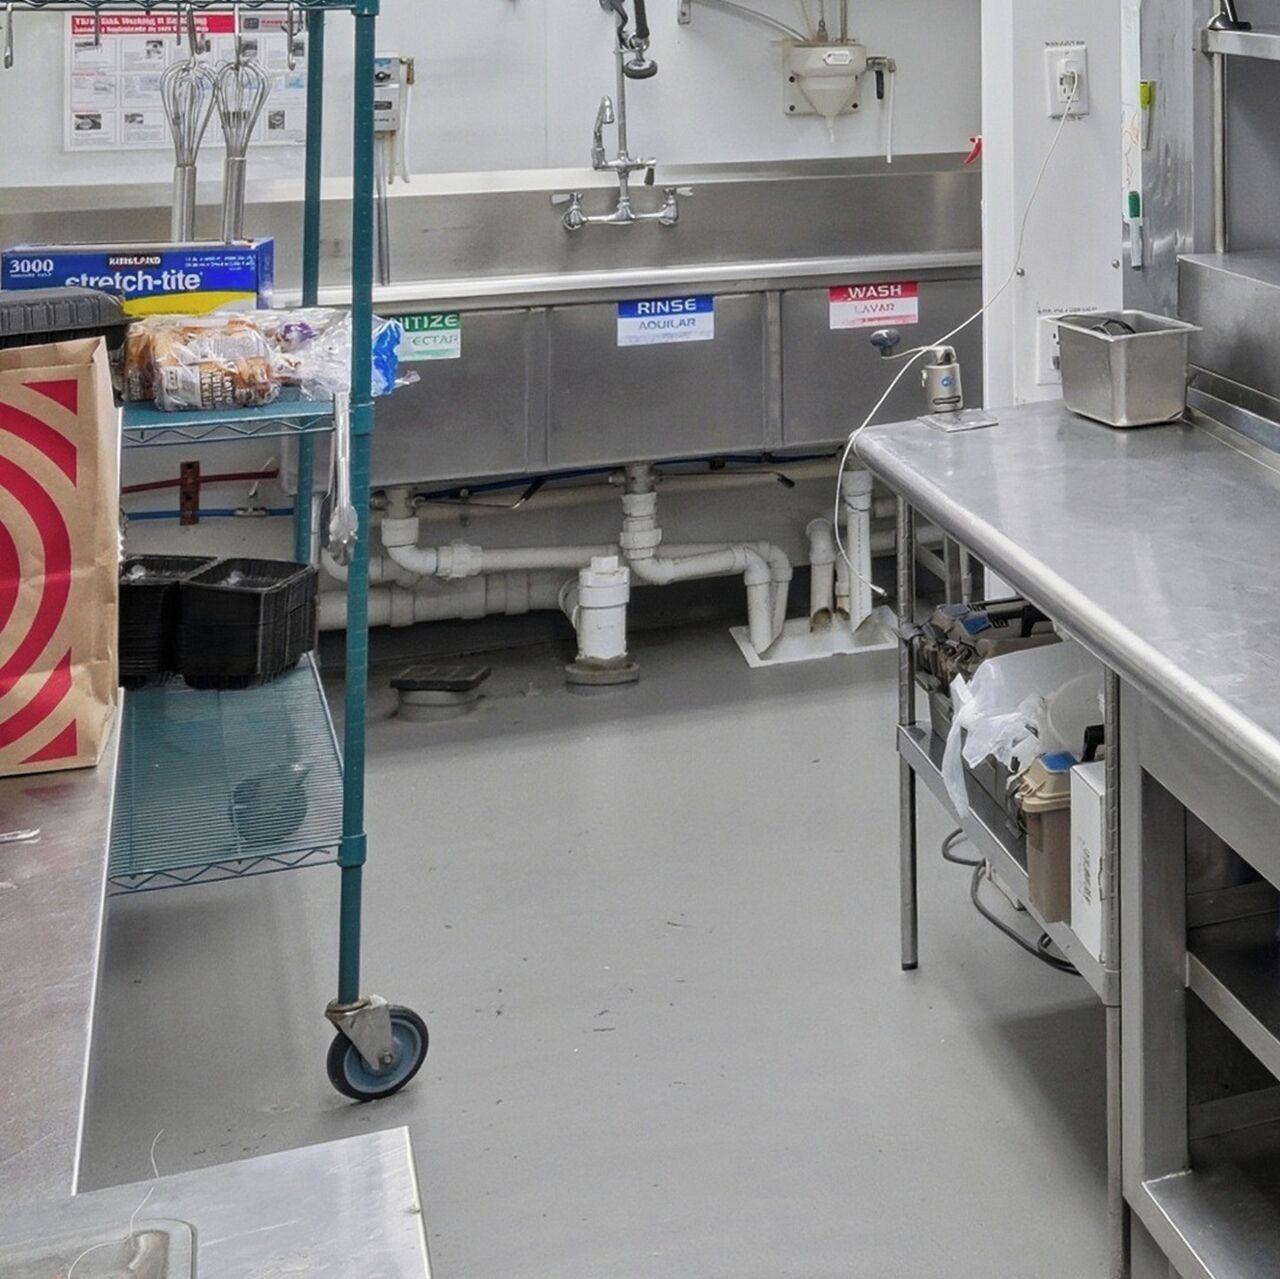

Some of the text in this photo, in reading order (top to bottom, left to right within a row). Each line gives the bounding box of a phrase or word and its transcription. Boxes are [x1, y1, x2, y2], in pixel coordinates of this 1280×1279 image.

[9, 259, 55, 274] 3000
[65, 270, 201, 292] stretch-tite
[847, 284, 902, 299] WASH
[637, 298, 697, 315] RINSE
[854, 303, 895, 314] LAVAR
[400, 314, 458, 330] ITIZE
